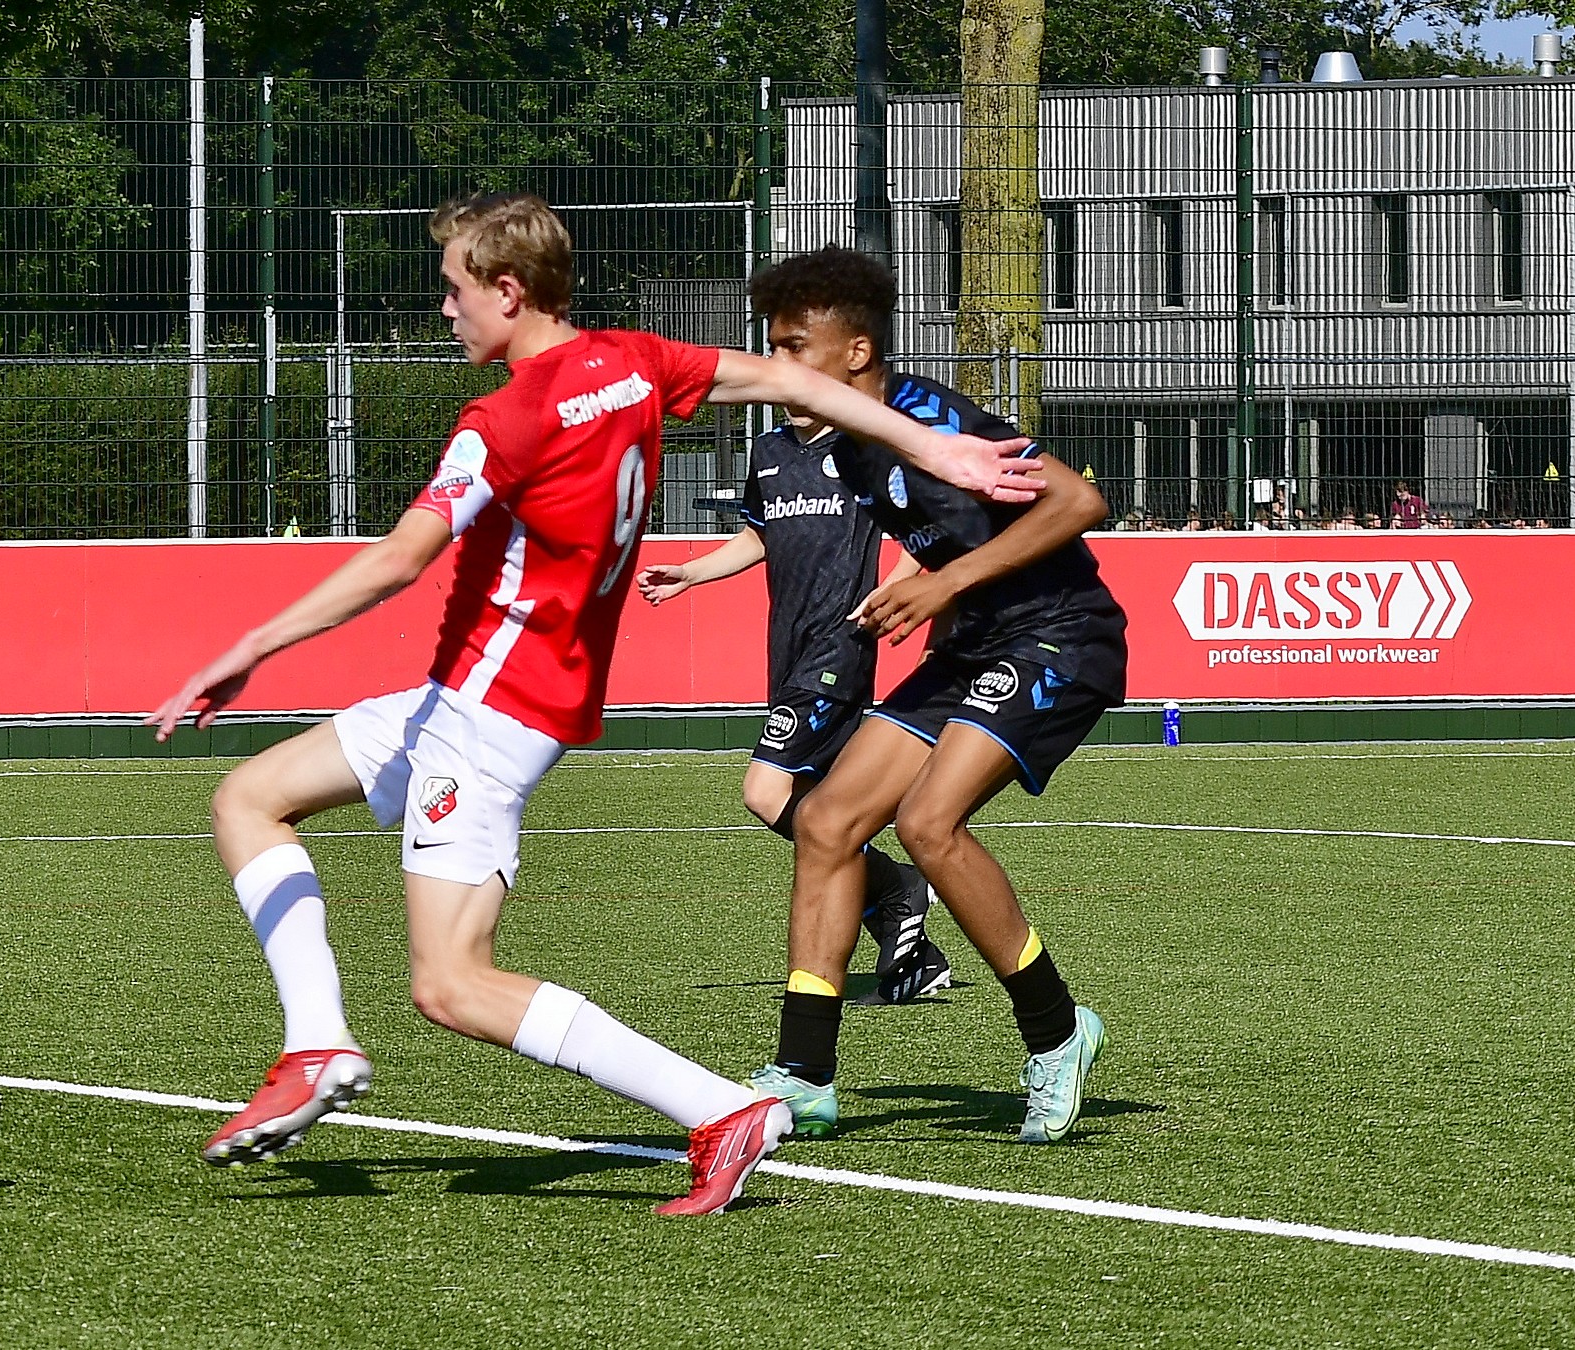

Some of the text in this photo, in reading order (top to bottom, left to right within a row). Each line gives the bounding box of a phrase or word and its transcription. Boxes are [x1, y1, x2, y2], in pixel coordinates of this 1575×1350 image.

[597, 444, 646, 597] 9
[1204, 572, 1403, 629] DASSY
[1208, 643, 1439, 668] professional workwear
